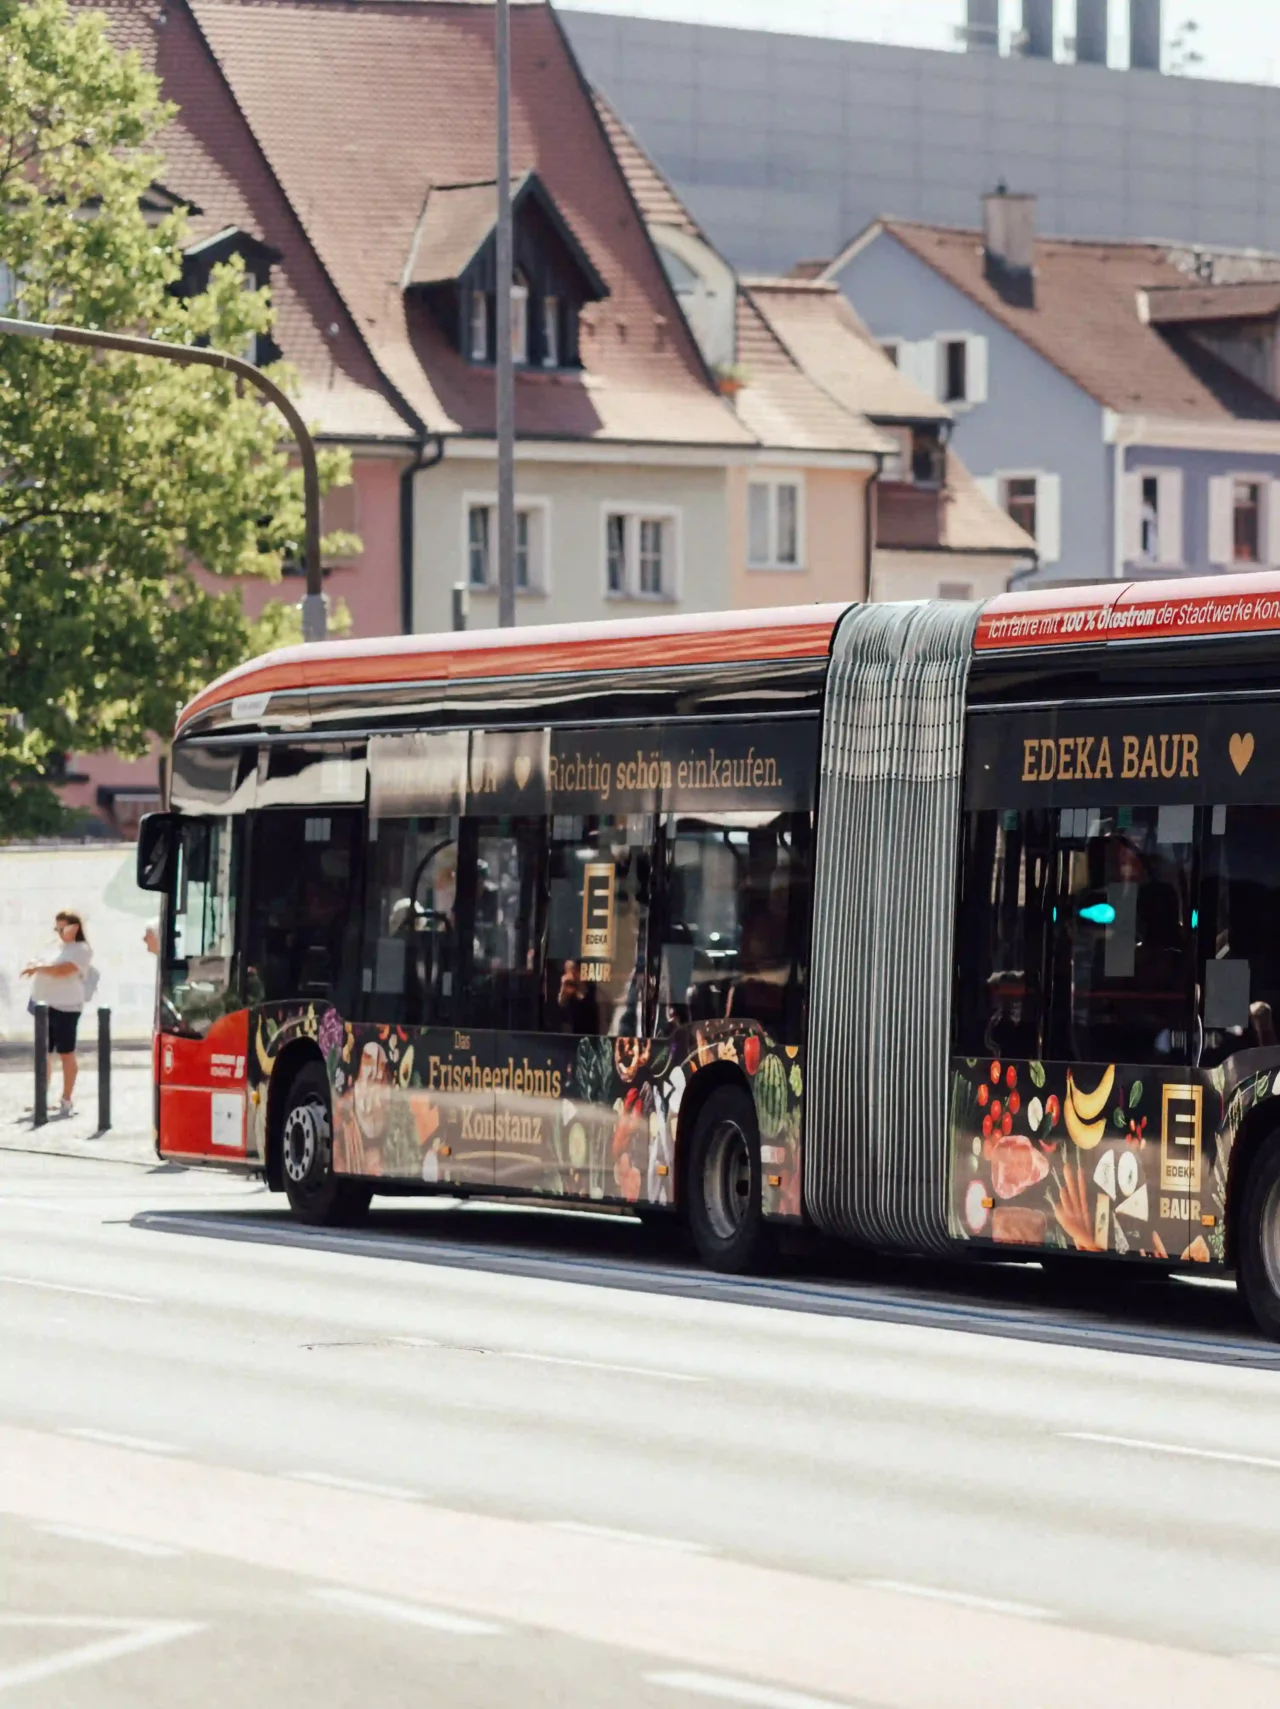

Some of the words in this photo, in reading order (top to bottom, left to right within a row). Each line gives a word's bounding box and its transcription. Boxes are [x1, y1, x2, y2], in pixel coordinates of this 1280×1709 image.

[988, 616, 1007, 638] Ich
[1007, 615, 1039, 637] fahre
[1039, 615, 1061, 634] mit
[1061, 611, 1085, 633] 100
[1084, 610, 1098, 631] %
[1097, 603, 1156, 629] Ökostrom
[1156, 602, 1178, 625] der
[1177, 599, 1255, 625] Stadtwerke
[1022, 736, 1114, 782] EDEKA
[1120, 733, 1200, 779] BAUR
[545, 753, 611, 800] Richtig
[616, 750, 673, 790] schön
[677, 747, 783, 788] einkaufen.
[585, 934, 608, 945] EDEKA
[580, 962, 611, 982] BAUR
[454, 1030, 471, 1050] Das
[428, 1054, 562, 1098] Frischeerlebnis
[461, 1104, 542, 1144] Konstanz
[1166, 1165, 1196, 1178] EDEKA
[1160, 1197, 1201, 1221] BAUR
